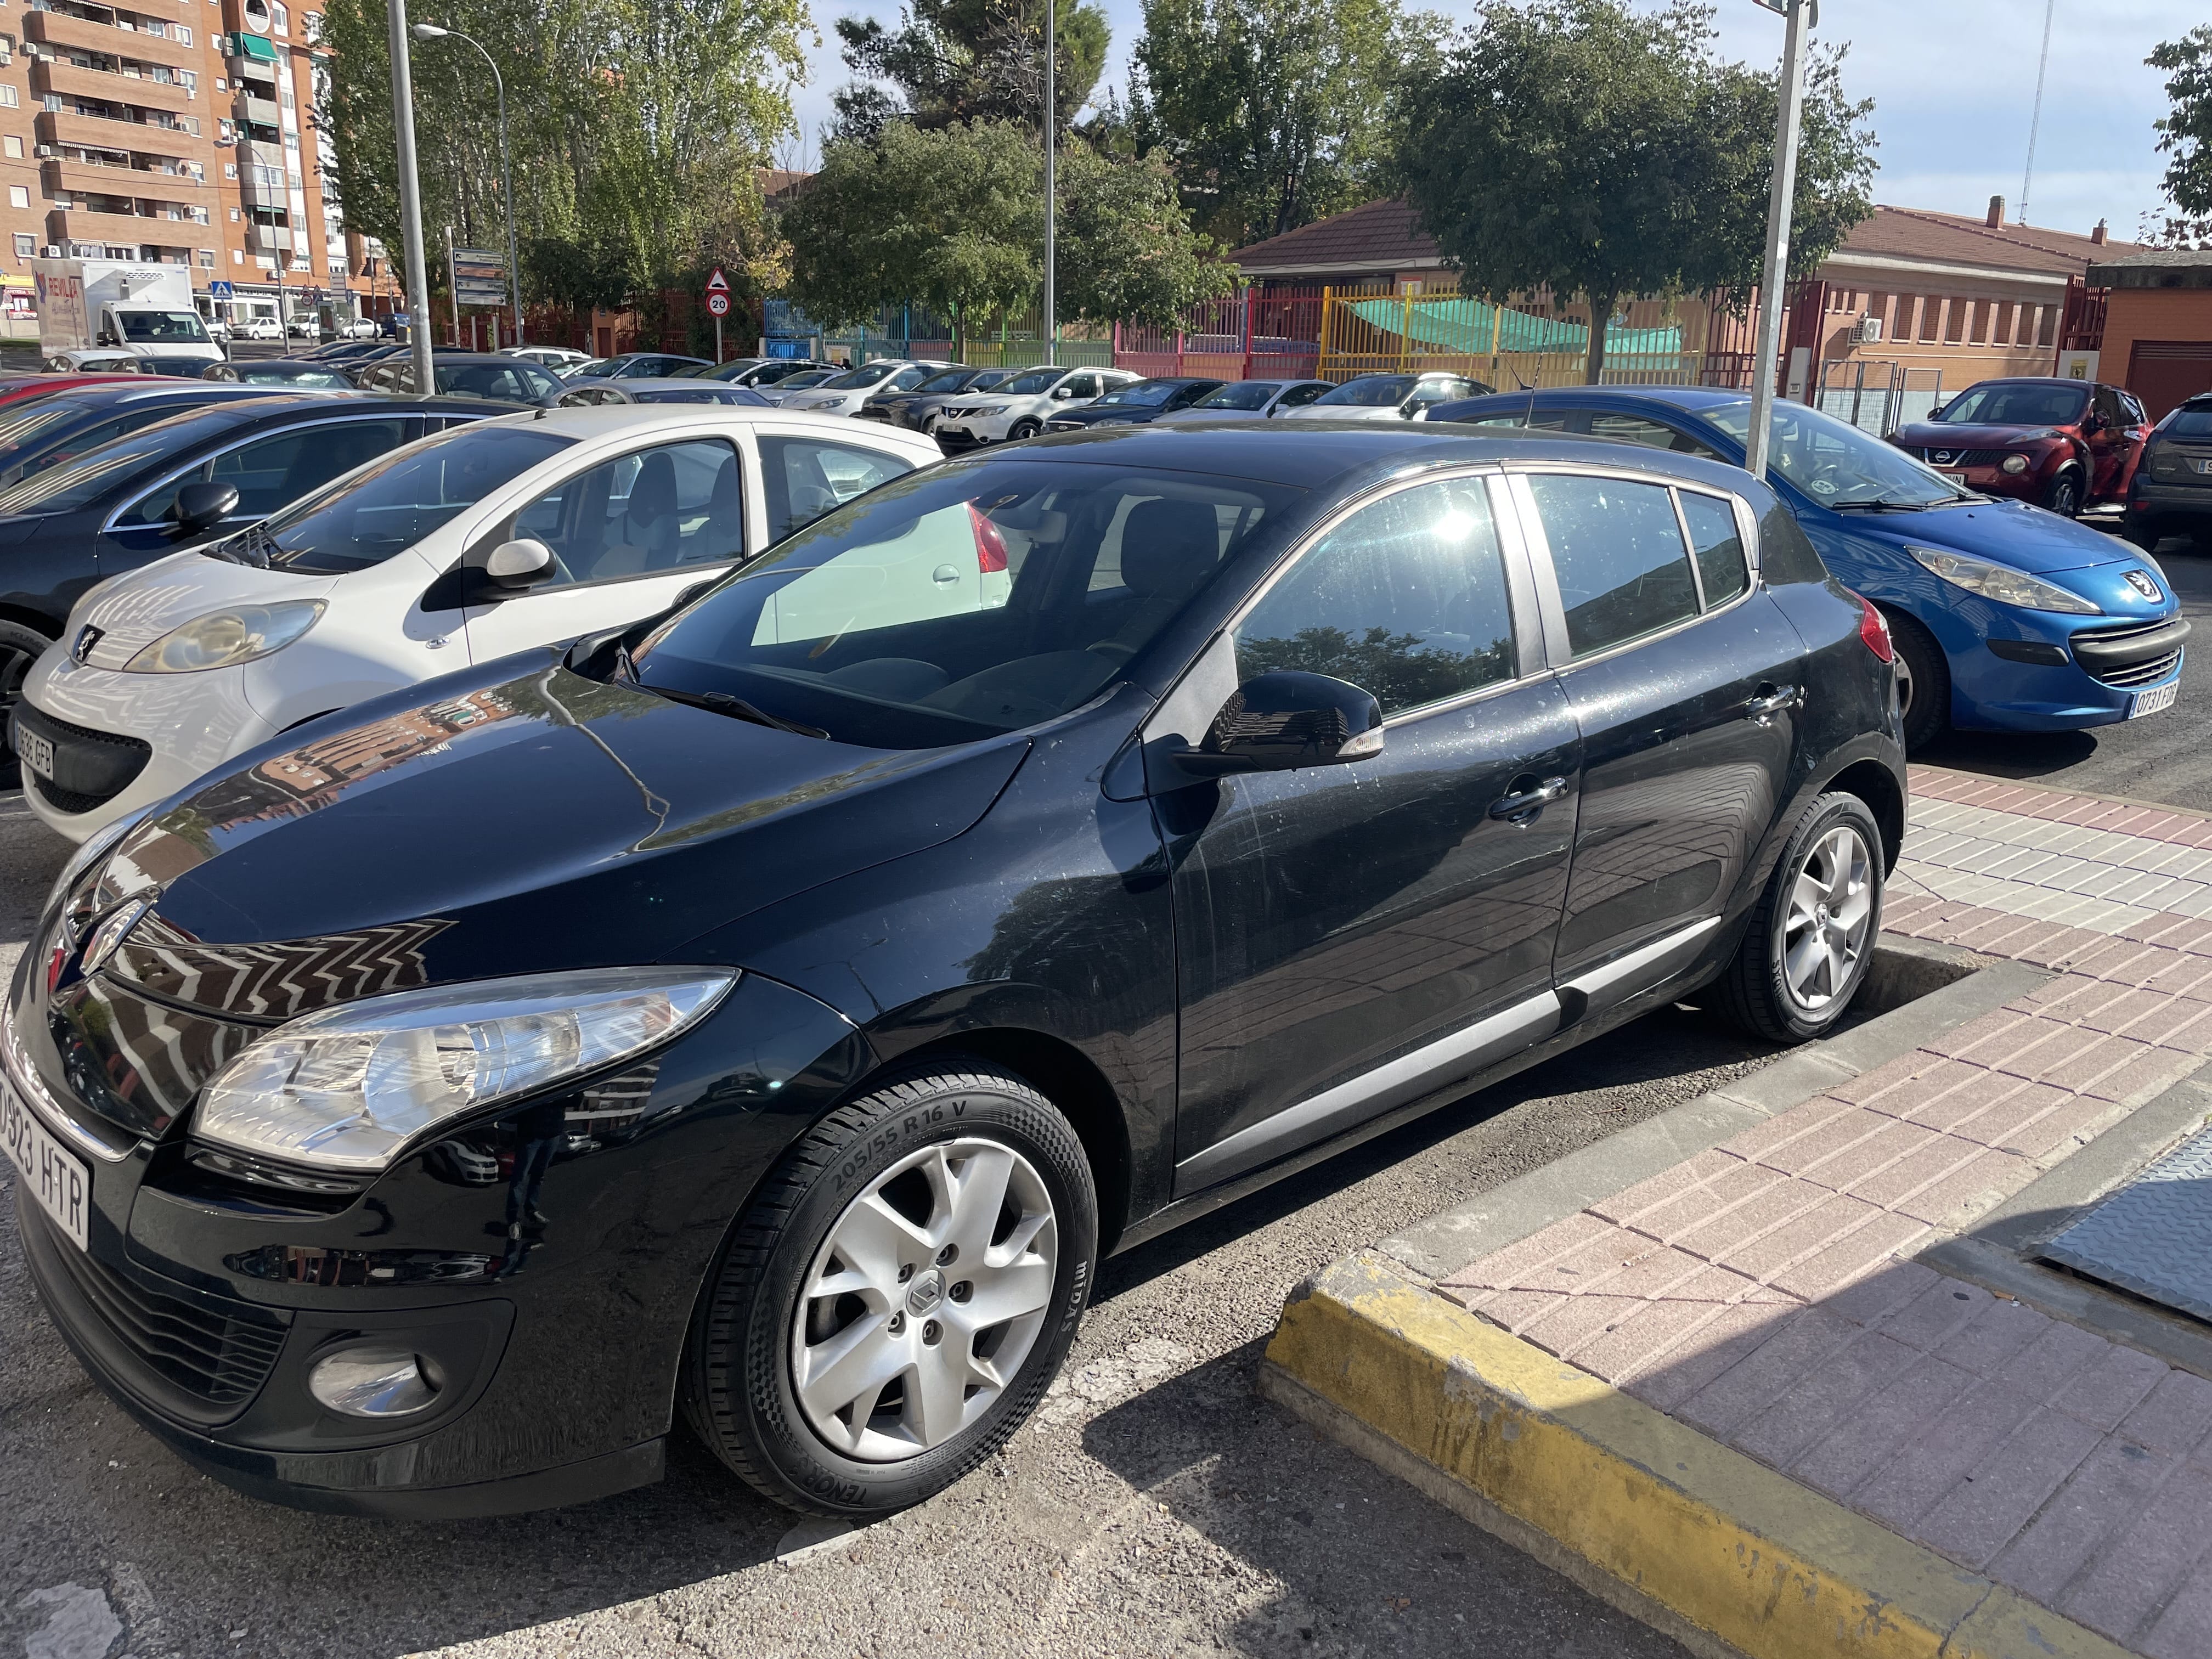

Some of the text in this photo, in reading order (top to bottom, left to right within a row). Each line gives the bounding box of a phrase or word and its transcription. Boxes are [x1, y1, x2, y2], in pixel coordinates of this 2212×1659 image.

[48, 277, 78, 299] REVILLA
[712, 300, 725, 308] 20
[2137, 683, 2176, 713] 0731 FDR
[18, 726, 50, 773] 0636 GFB
[0, 1081, 82, 1235] 0923 HTR
[831, 1126, 898, 1193] 205/55
[922, 1105, 944, 1125] 16
[952, 1100, 967, 1116] V
[801, 1467, 867, 1506] TENOR
